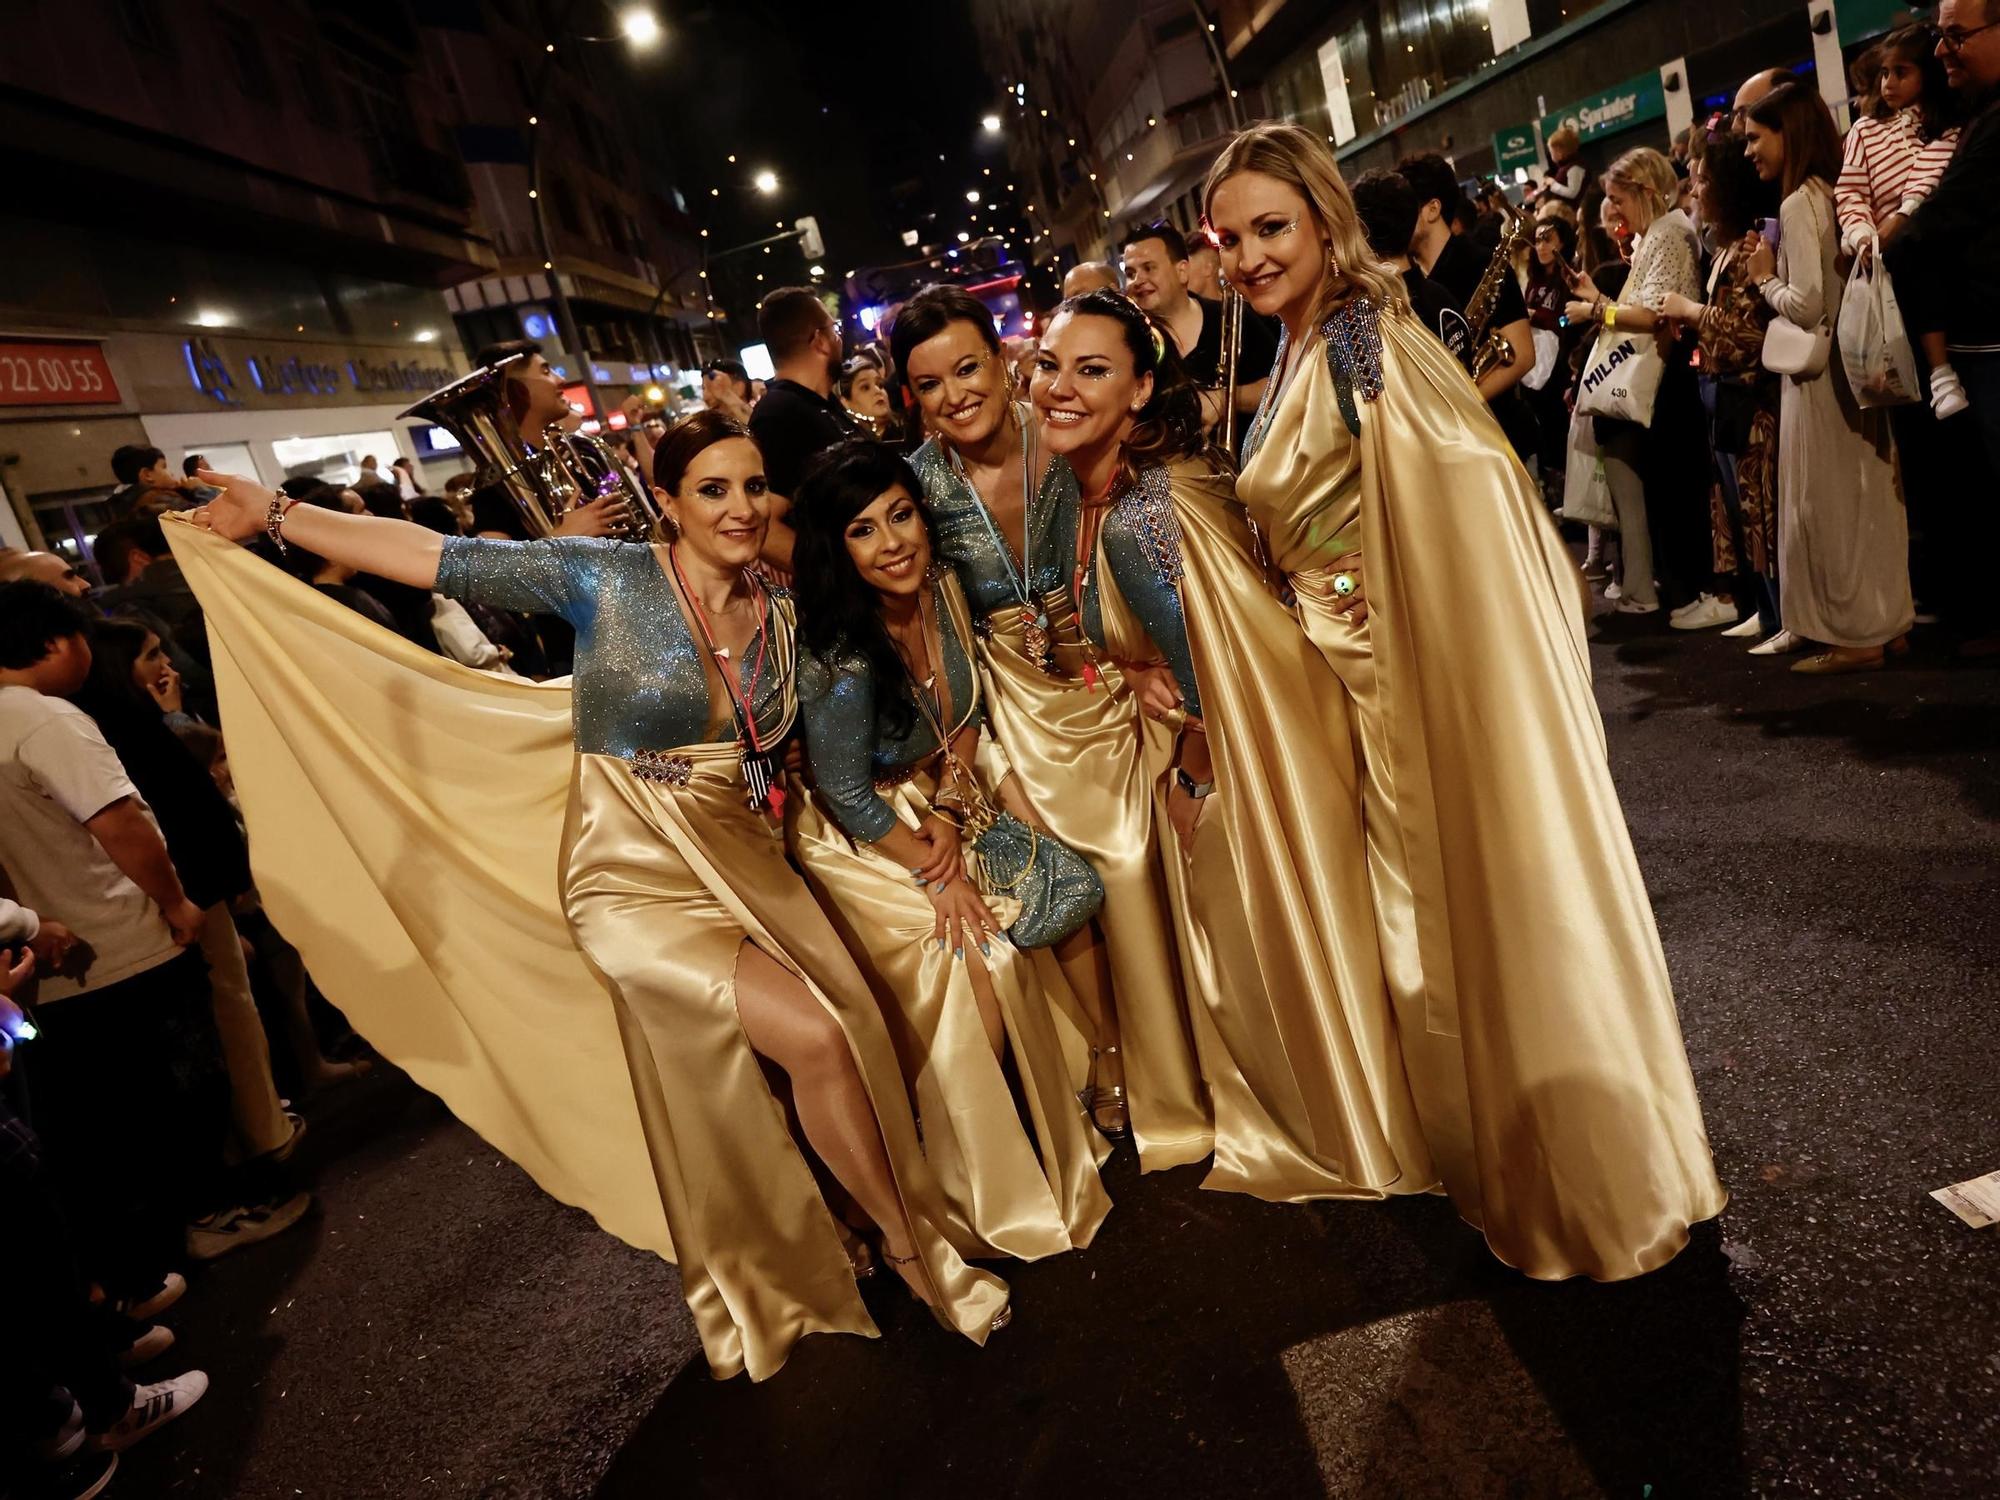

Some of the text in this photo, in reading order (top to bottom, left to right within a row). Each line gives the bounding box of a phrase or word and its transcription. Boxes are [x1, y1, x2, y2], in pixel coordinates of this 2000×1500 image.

[1578, 93, 1637, 133] Sprinter
[2, 357, 103, 391] 22 00 55
[1583, 339, 1636, 393] MILAN
